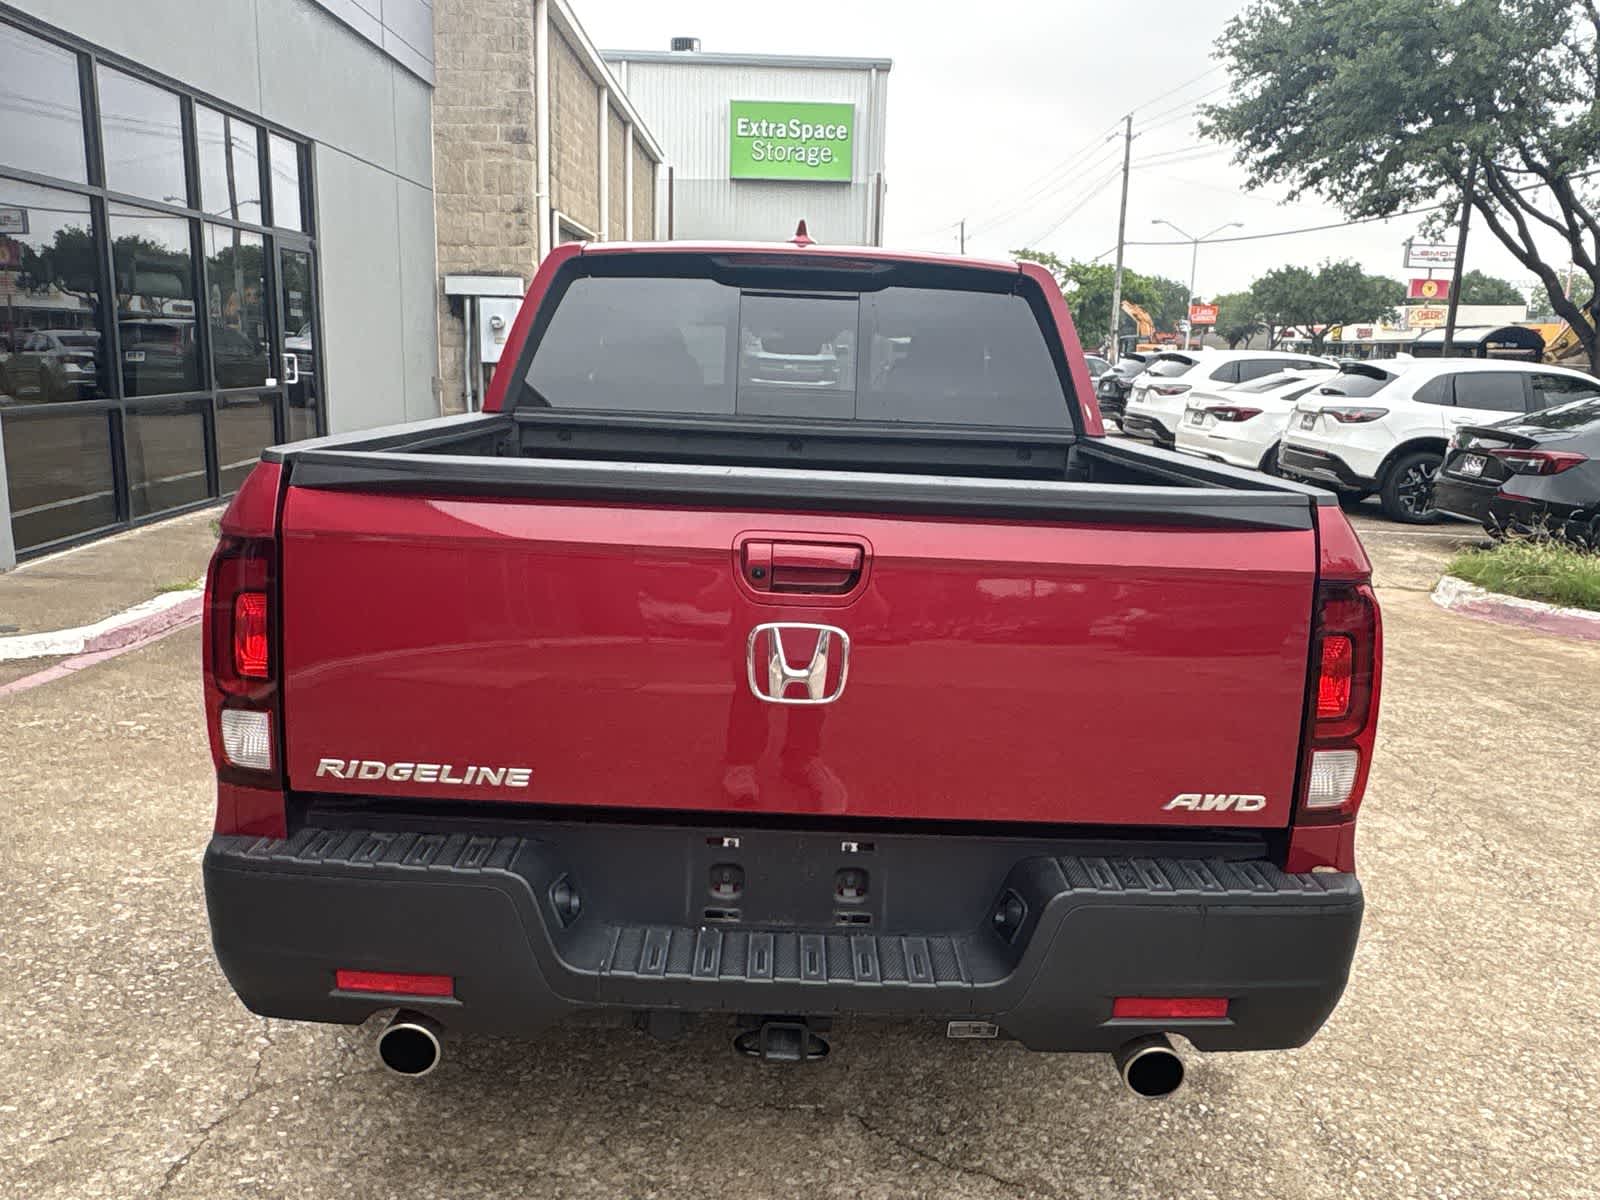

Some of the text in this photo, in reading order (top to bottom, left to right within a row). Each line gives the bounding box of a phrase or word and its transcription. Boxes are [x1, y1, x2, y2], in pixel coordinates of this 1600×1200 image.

[752, 139, 833, 166] Storage
[315, 757, 533, 788] RIDGELINE
[1161, 793, 1266, 811] AWD
